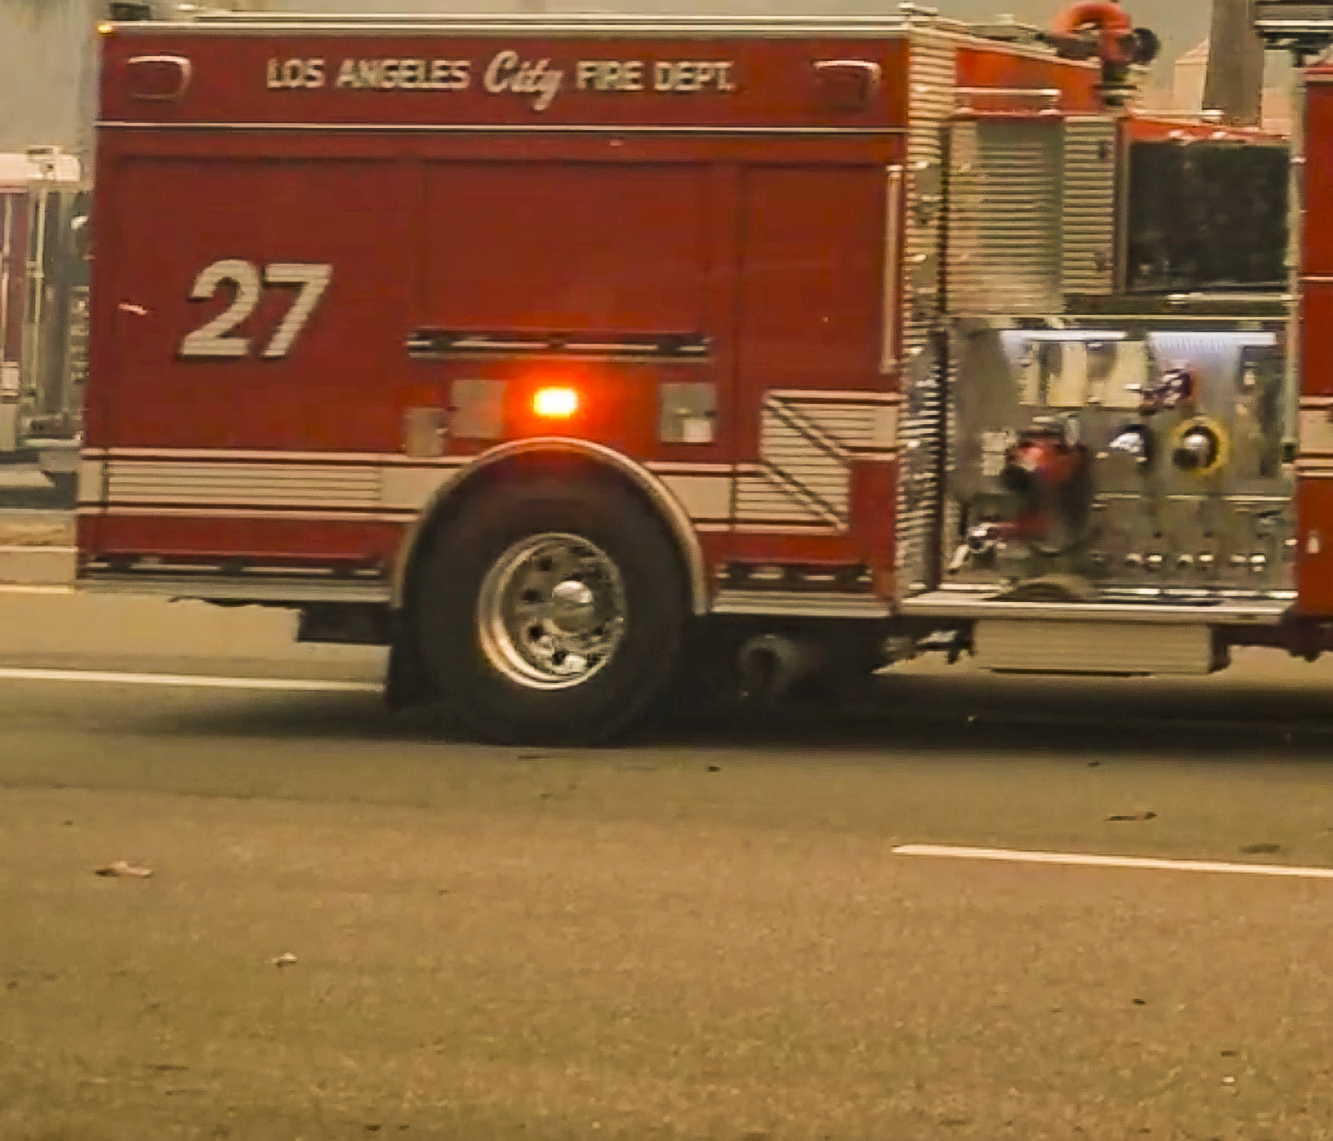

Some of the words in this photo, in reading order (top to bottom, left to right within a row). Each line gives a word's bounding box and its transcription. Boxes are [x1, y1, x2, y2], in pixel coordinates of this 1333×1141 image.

[266, 59, 325, 89] LOS
[336, 59, 472, 89] ANGELES
[484, 50, 564, 111] City
[576, 60, 644, 91] FIRE
[180, 259, 334, 356] 27
